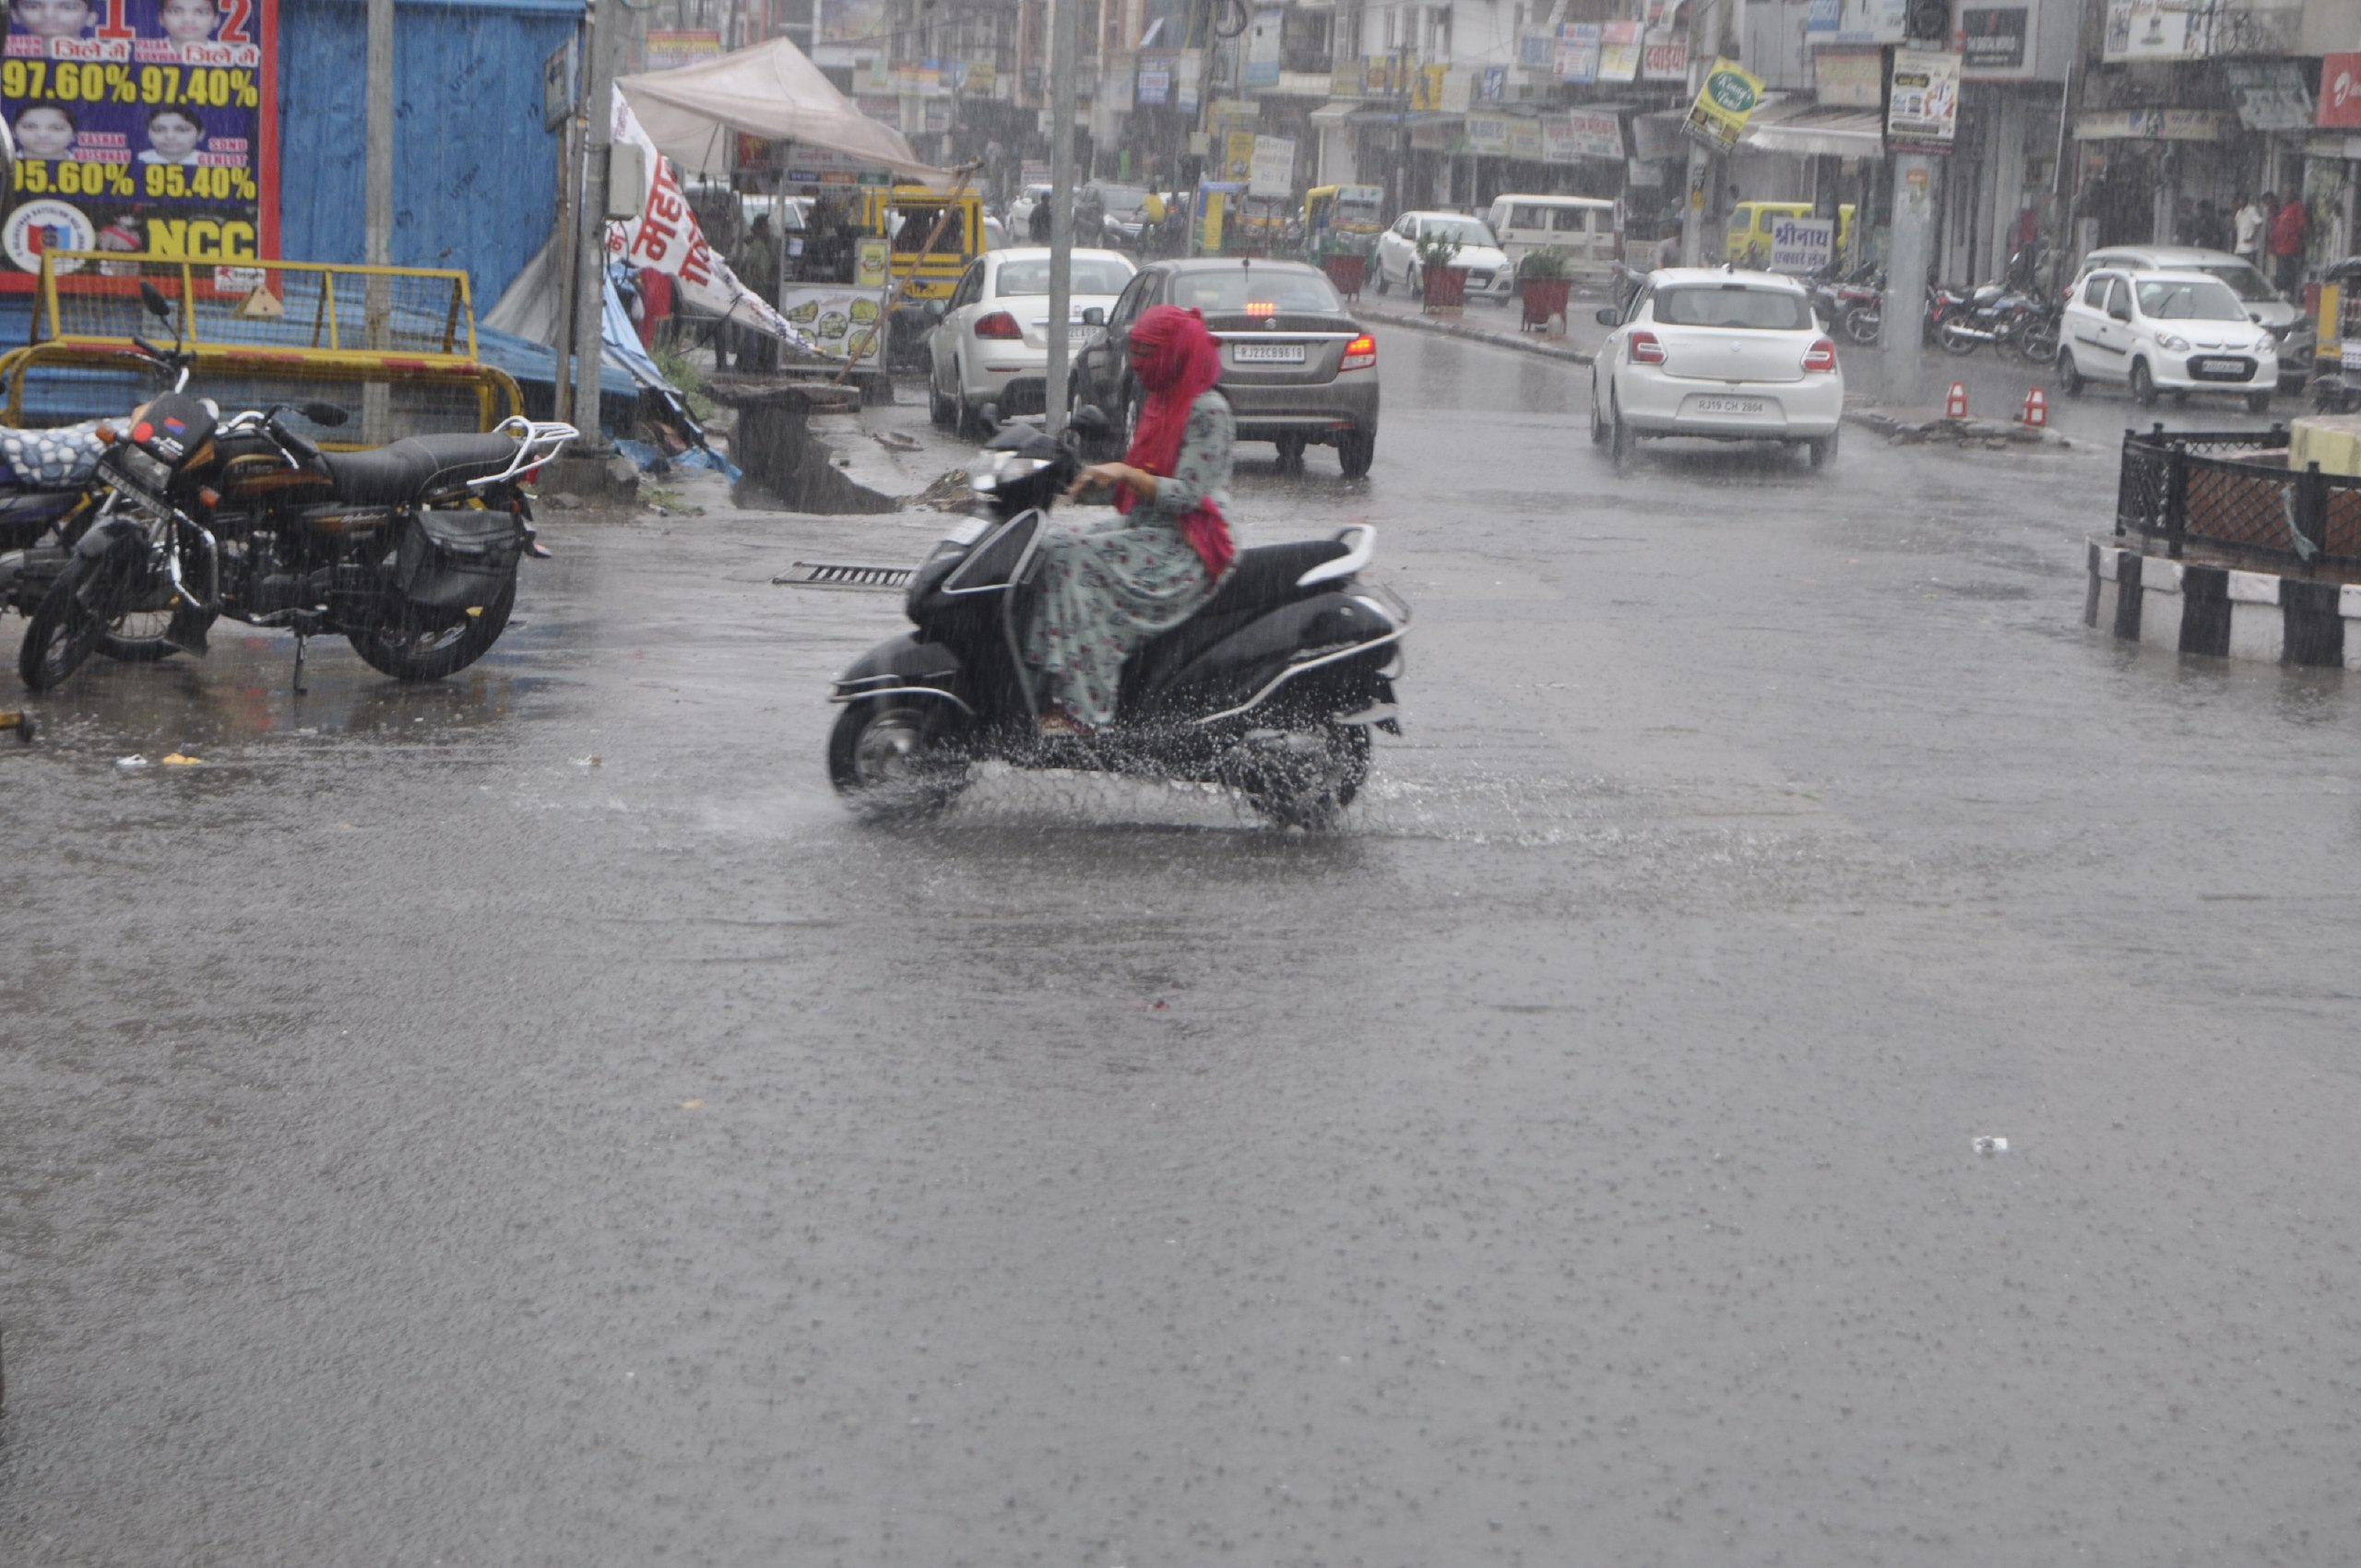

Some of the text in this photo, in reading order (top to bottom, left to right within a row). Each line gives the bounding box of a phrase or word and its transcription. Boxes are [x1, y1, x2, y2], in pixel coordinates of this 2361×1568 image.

[54, 40, 101, 58] जिले
[186, 44, 231, 63] जिले
[2, 60, 136, 101] 97.60%
[140, 65, 258, 107] 97.40%
[145, 164, 256, 199] 95.40%
[147, 218, 255, 260] NCC
[1775, 221, 1830, 247] श्रीनाथ
